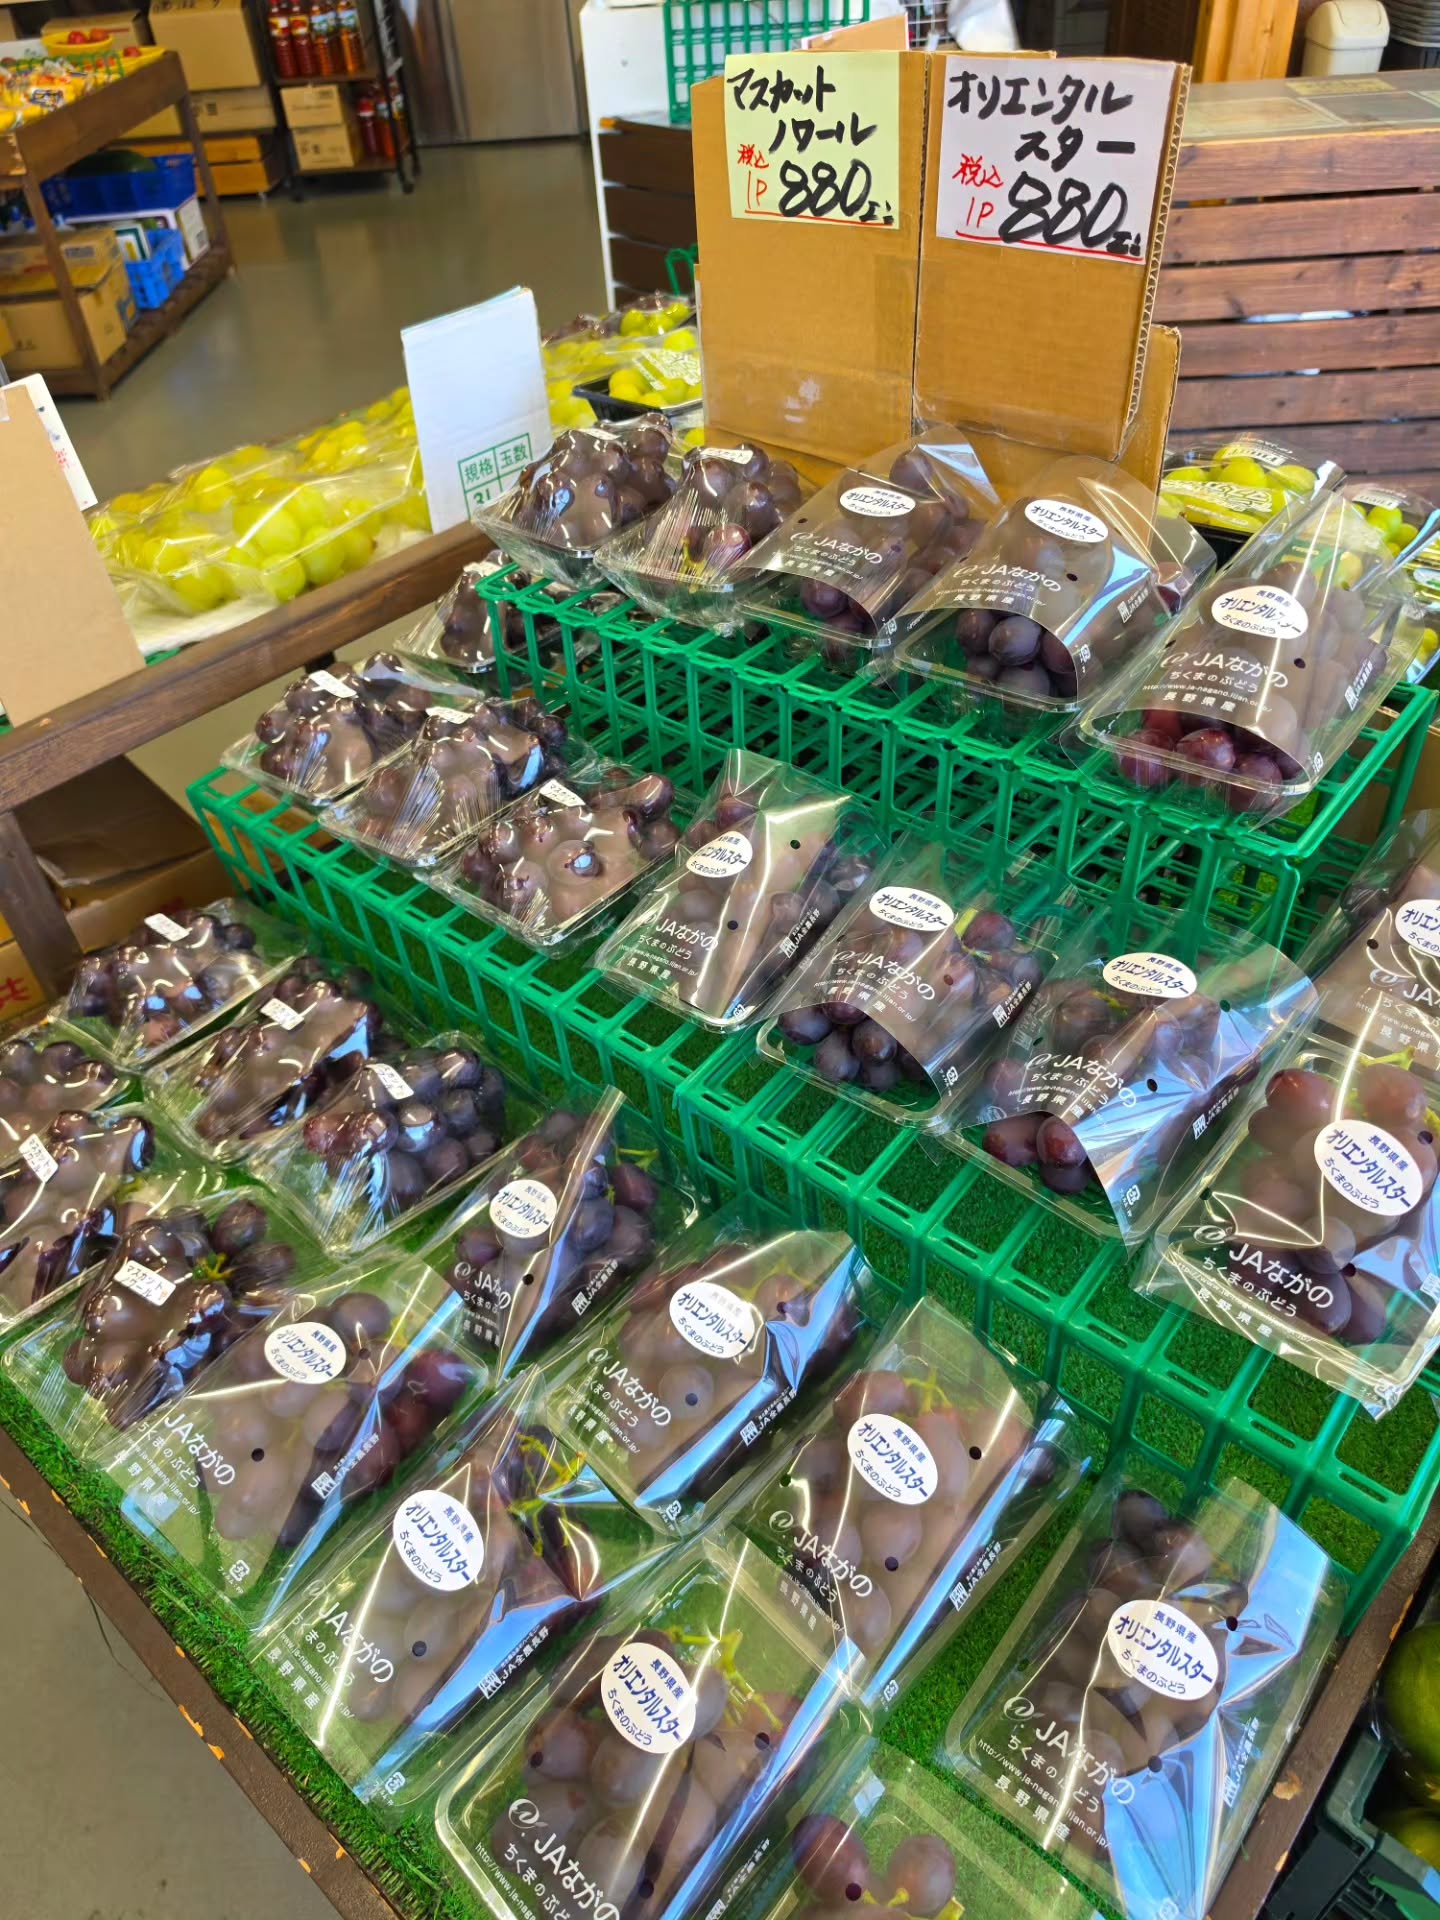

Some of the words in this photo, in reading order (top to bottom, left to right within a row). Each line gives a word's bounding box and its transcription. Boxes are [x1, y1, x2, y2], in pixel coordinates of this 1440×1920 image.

[727, 66, 836, 113] マスカット
[947, 70, 1135, 124] オリエンタル
[736, 143, 771, 169] 税込
[768, 111, 877, 154] ノワール
[1014, 125, 1137, 171] スター
[951, 153, 1004, 189] 税込
[465, 458, 493, 483] 規格
[500, 443, 529, 470] 玉数
[1030, 505, 1105, 538] オリエンタルスター
[813, 536, 883, 565] JAながの
[981, 564, 1062, 592] JAながの
[1169, 671, 1259, 693] ちくまのぶどう
[1192, 652, 1289, 688] JAながの
[655, 918, 719, 951] JAながの
[876, 893, 948, 927] オリエンタルスター
[638, 934, 693, 960] ちくまのぶどう
[857, 951, 936, 1001] JAながの
[1110, 959, 1190, 996] オリエンタルスター
[1053, 1054, 1138, 1108] JAながの
[1326, 1127, 1412, 1209] オリエンタルスター
[1368, 1134, 1410, 1173] 長野県産
[1322, 1156, 1381, 1210] ちくまのぶどう
[498, 1190, 551, 1227] オリエンタルスター
[1202, 1255, 1298, 1319] ちくまのぶどう
[1228, 1242, 1335, 1310] JAながの
[677, 1292, 748, 1346] オリエンタルスター
[276, 1329, 334, 1378] オリエンタルスター
[601, 1359, 673, 1428] JAながの
[163, 1413, 237, 1486] JAながの
[855, 1420, 930, 1499] オリエンタルスター
[892, 1426, 930, 1465] 長野県産
[853, 1446, 903, 1500] ちくまのぶどう
[398, 1529, 443, 1585] ちくまのぶどう
[404, 1501, 472, 1583] オリエンタルスター
[793, 1529, 874, 1599] JAながの
[318, 1600, 395, 1685] JAながの
[1113, 1614, 1214, 1686] オリエンタルスター
[1152, 1609, 1198, 1646] 長野県産
[266, 1646, 322, 1711] 長野県産
[649, 1657, 685, 1702] 長野県産
[1120, 1647, 1188, 1696] ちくまのぶどう
[605, 1686, 655, 1747] ちくまのぶどう
[611, 1653, 683, 1743] オリエンタルスター
[1034, 1720, 1136, 1806] JAながの
[994, 1773, 1072, 1843] 長野県産
